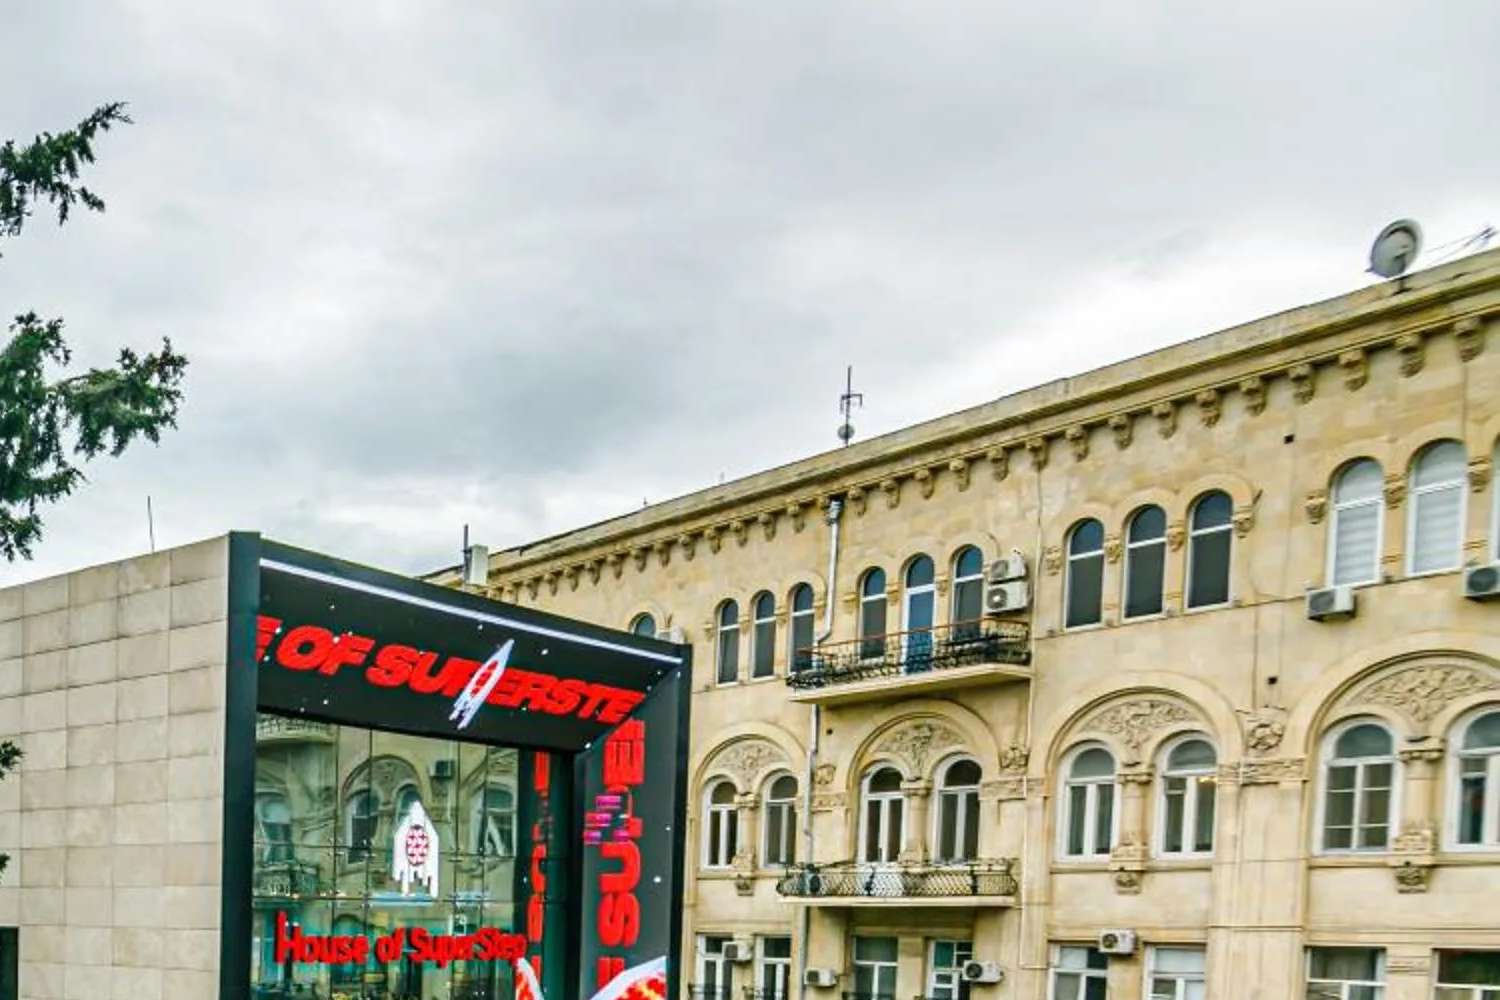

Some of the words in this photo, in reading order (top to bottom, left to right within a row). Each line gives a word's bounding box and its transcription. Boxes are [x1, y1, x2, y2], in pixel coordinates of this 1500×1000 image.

[276, 624, 376, 676] OF
[275, 910, 368, 966] House
[375, 926, 405, 964] of
[408, 926, 527, 970] SuperStep
